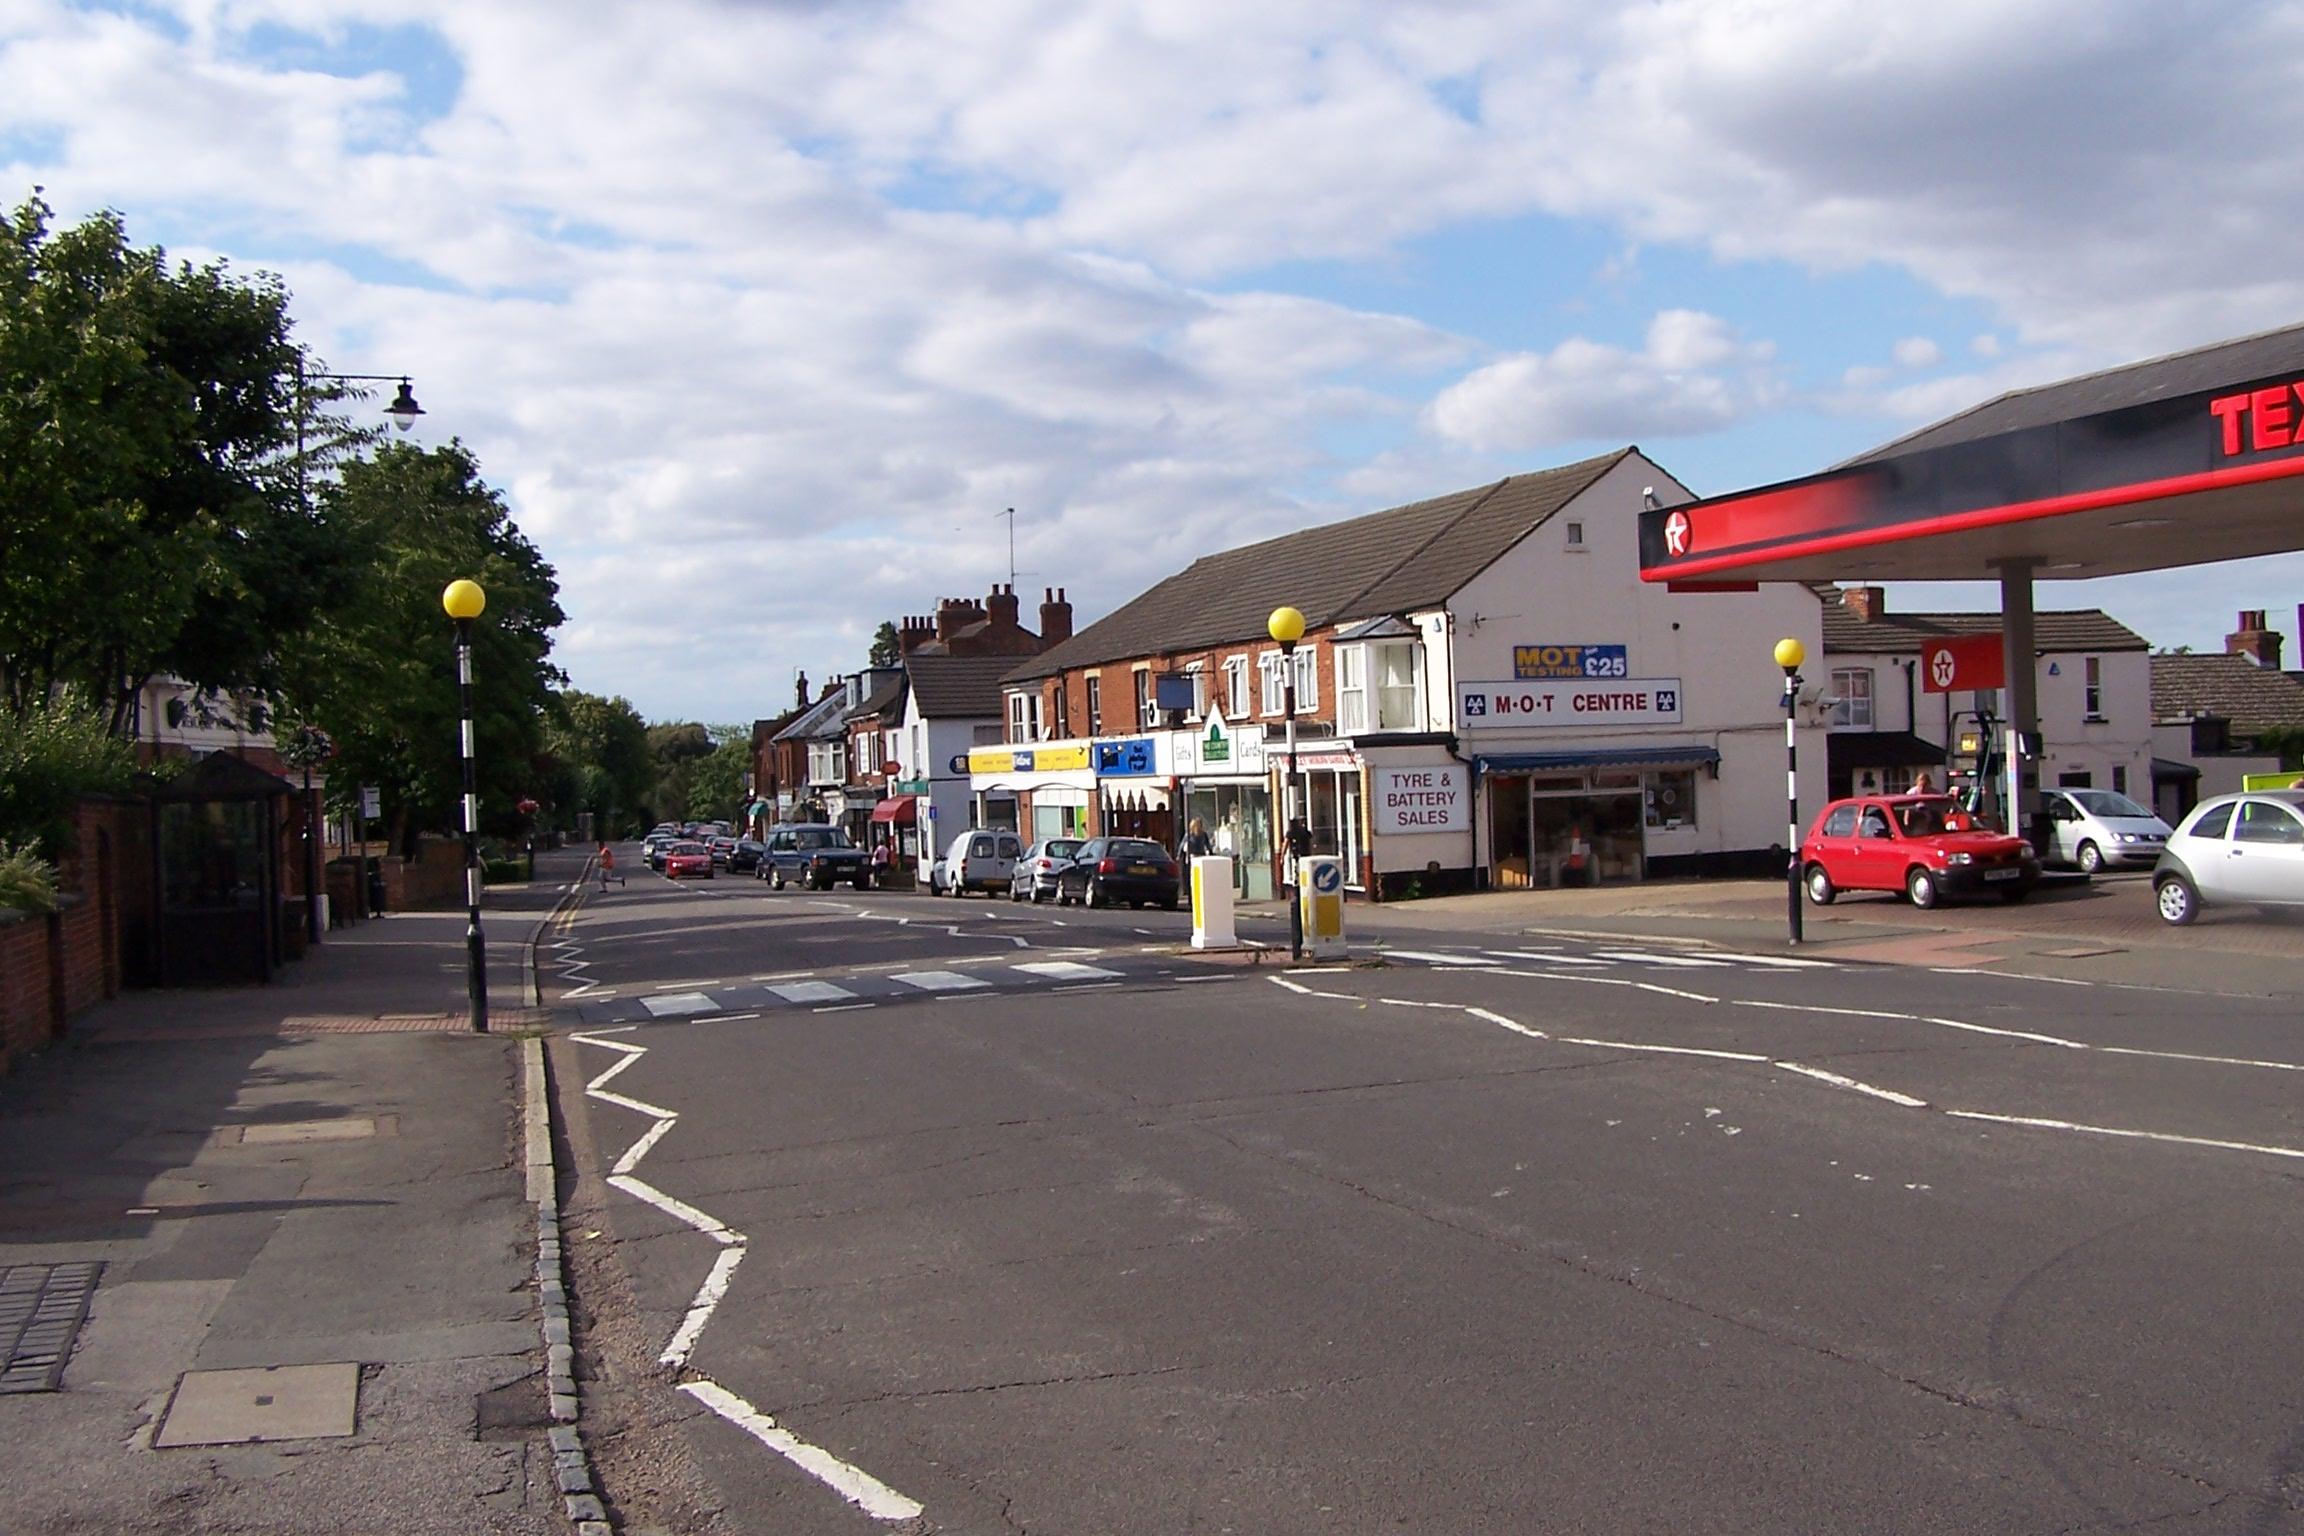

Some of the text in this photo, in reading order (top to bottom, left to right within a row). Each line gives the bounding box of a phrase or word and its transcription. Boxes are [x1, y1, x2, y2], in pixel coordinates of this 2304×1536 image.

[1517, 647, 1582, 665] MOT
[1518, 665, 1583, 676] TESTING
[1585, 657, 1625, 676] £25
[1573, 693, 1647, 712] CENTRE
[1241, 741, 1262, 757] Cards
[1391, 773, 1451, 788] TYRE &
[1387, 792, 1456, 807] BATTERY
[1398, 810, 1449, 826] SALES
